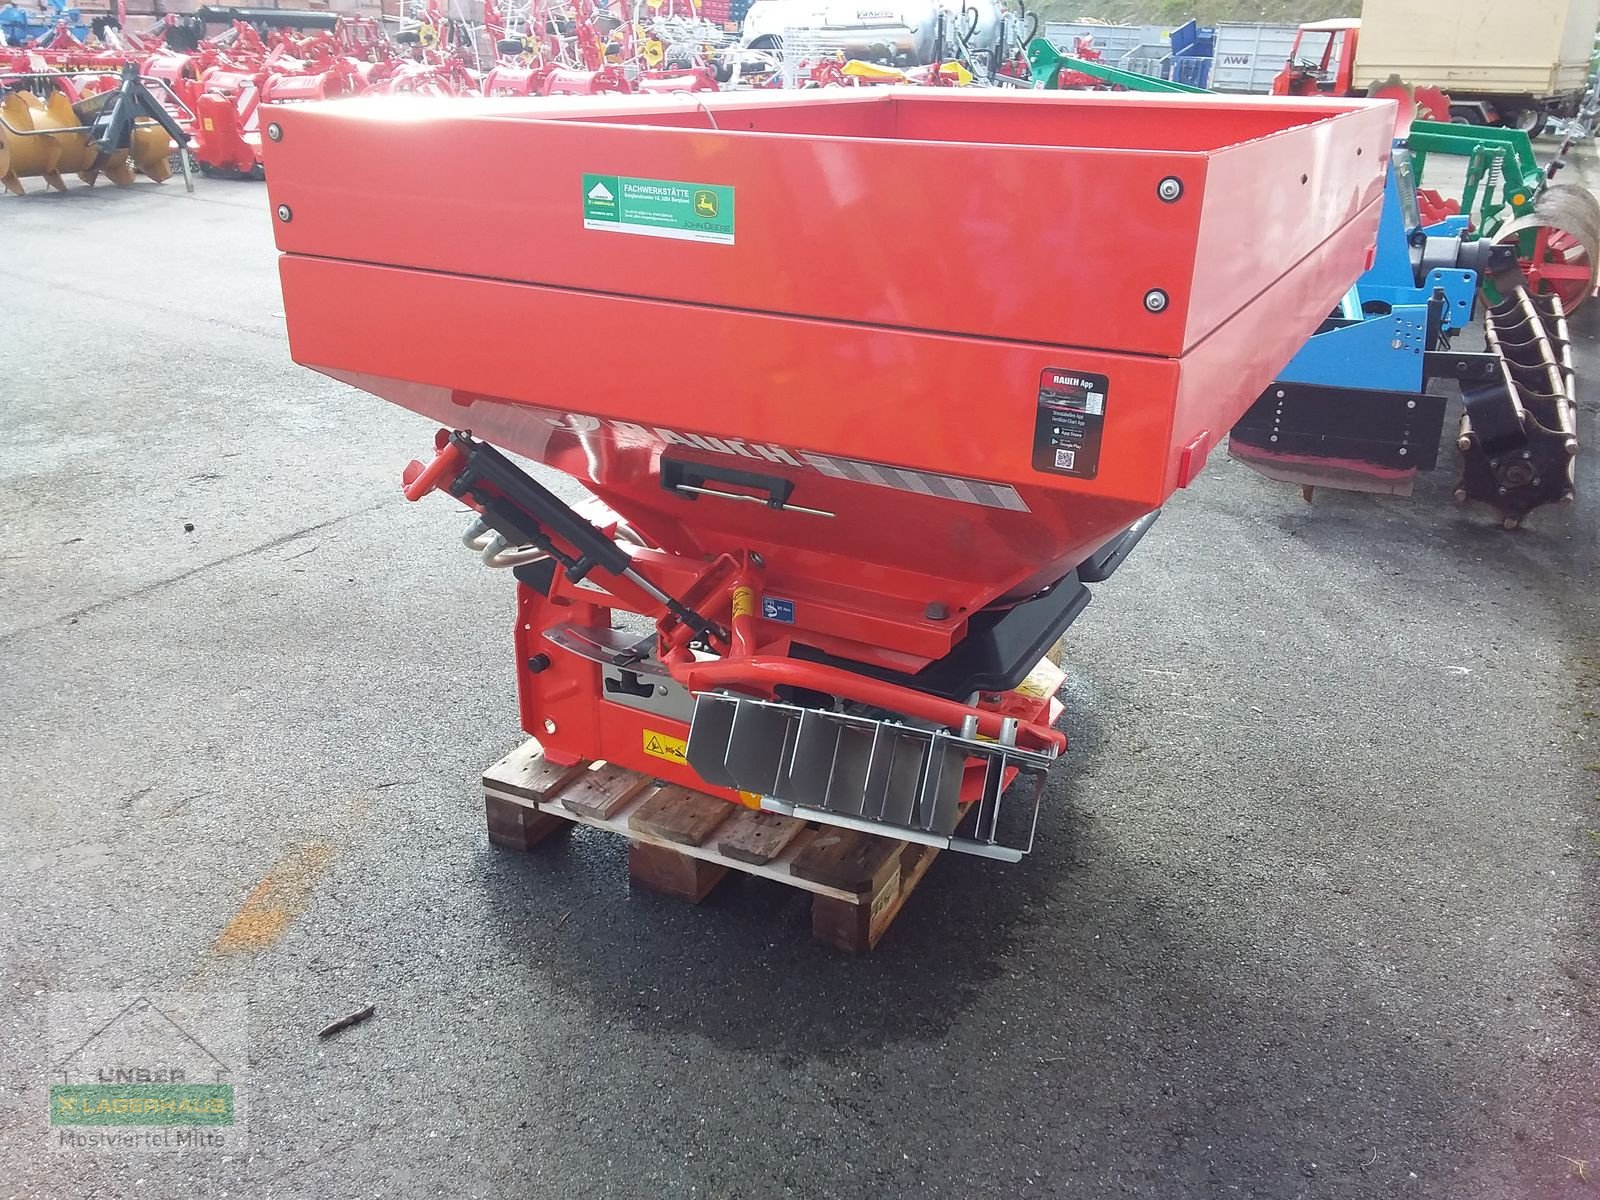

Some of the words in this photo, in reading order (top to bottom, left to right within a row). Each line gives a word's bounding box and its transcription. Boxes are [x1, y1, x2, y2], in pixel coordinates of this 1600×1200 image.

[624, 184, 690, 198] FACHWERKSTÄTTE
[682, 219, 703, 230] JOHN
[703, 221, 731, 233] DEERE
[1053, 375, 1079, 386] RAUCH
[1080, 379, 1094, 389] App
[608, 419, 803, 467] RAUCH
